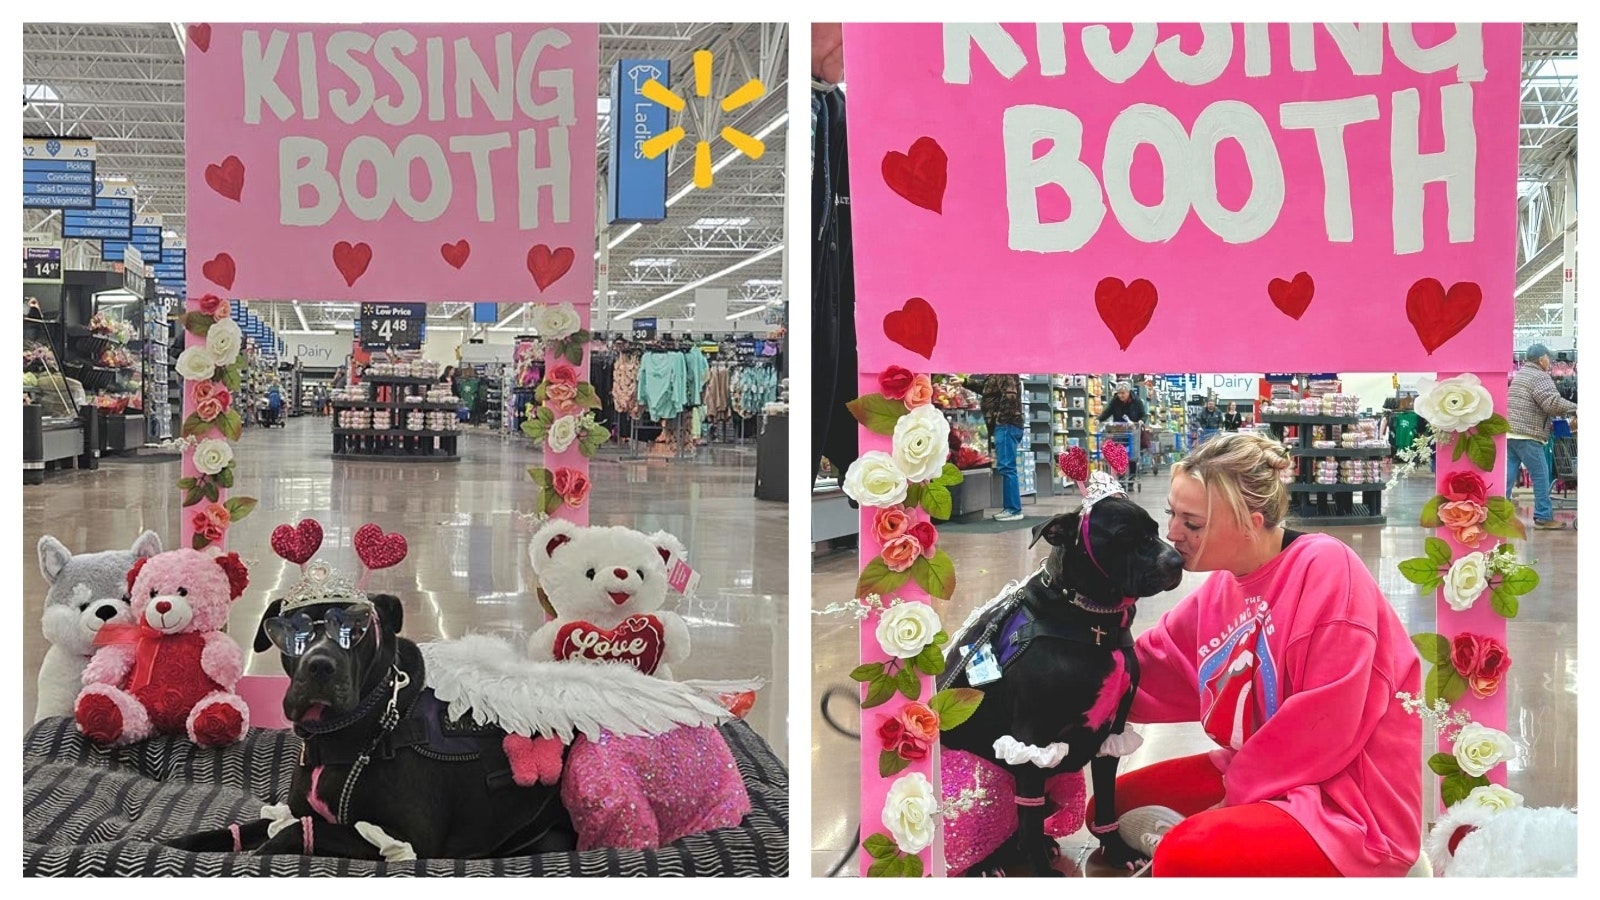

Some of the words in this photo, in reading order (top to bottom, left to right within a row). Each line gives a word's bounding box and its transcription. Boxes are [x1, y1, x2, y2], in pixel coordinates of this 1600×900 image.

[242, 28, 577, 126] KISSING
[74, 147, 89, 157] A3
[1003, 82, 1477, 255] BOOTH
[47, 173, 91, 181] Condiments
[279, 126, 571, 229] BOOTH
[115, 187, 128, 196] A5
[143, 217, 155, 225] A7
[376, 308, 391, 316] Low
[392, 308, 412, 316] Price
[297, 344, 332, 360] Dairy
[1213, 374, 1253, 393] Dairy
[1244, 595, 1262, 605] THE
[1198, 607, 1252, 658] ROLLING
[570, 628, 648, 659] Love
